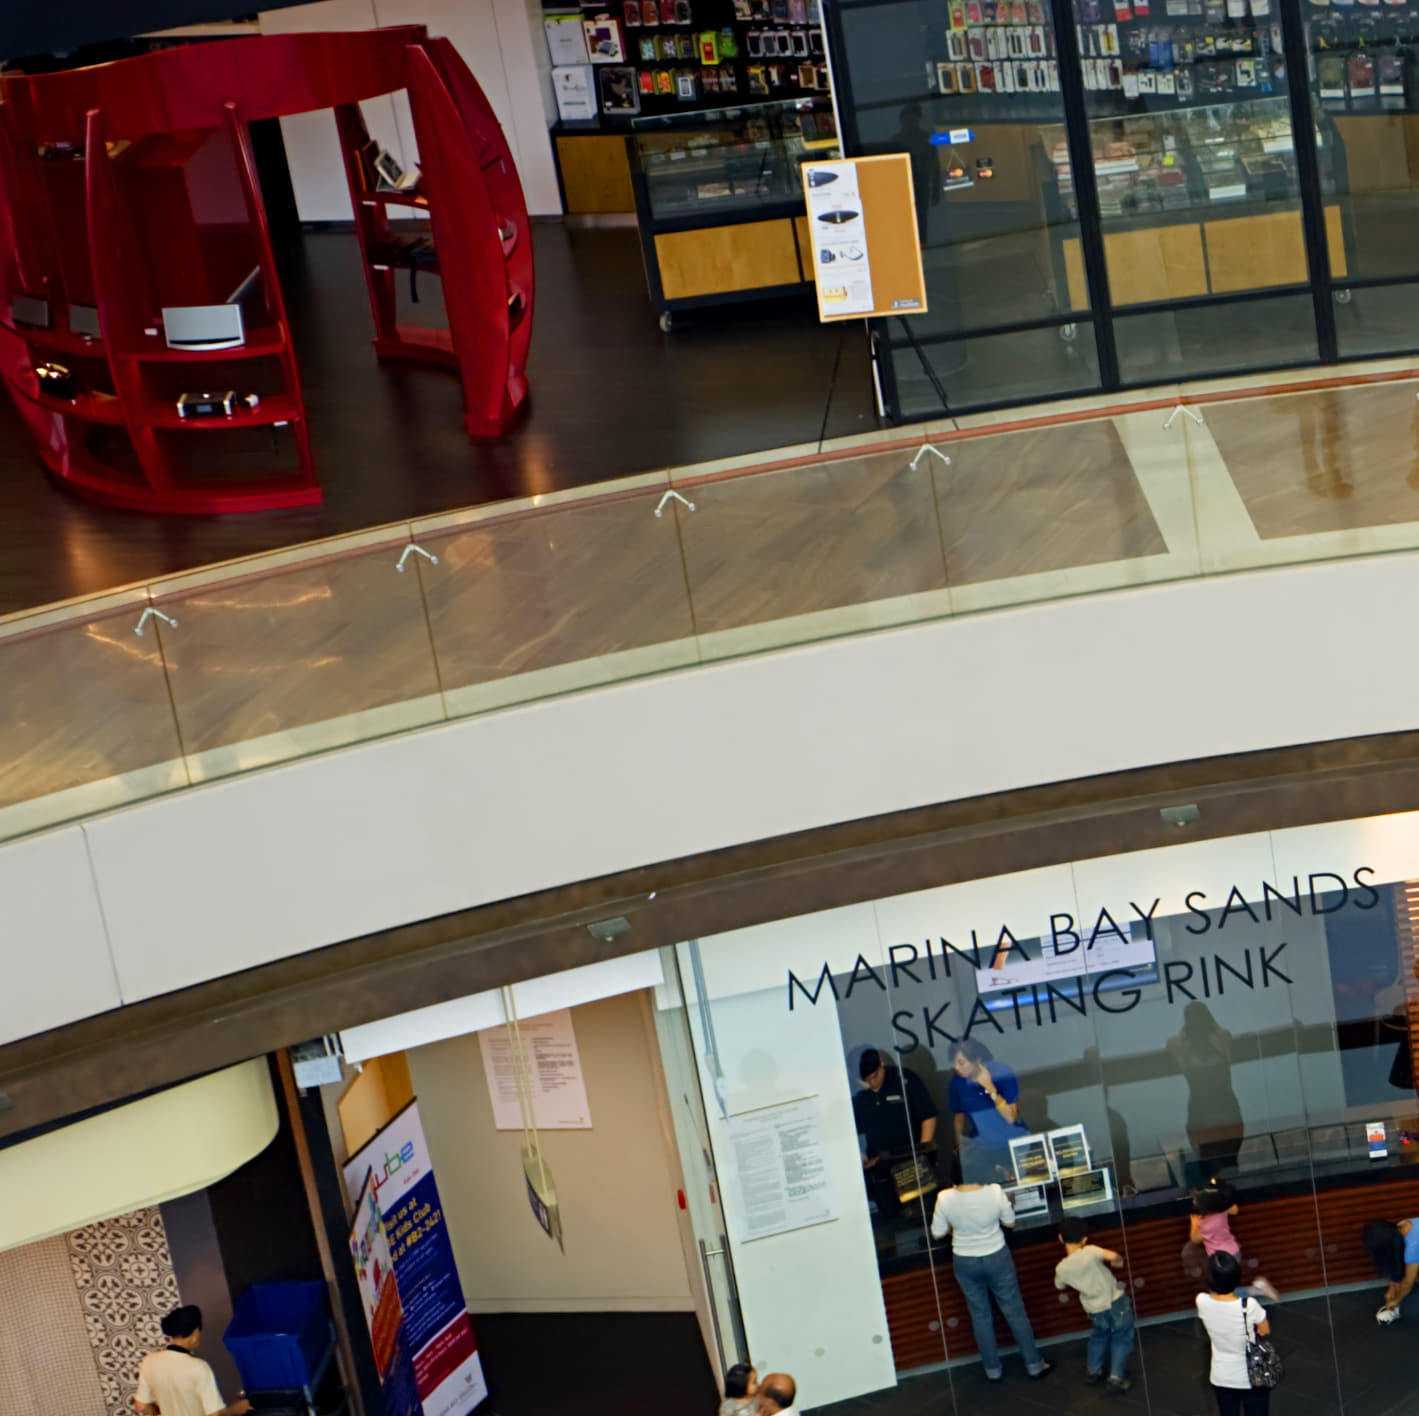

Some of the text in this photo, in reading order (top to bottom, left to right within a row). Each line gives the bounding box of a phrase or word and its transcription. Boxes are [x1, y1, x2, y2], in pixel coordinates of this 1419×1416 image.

[789, 867, 1381, 1011] MARINA BAY SANDS
[891, 942, 1293, 1055] SKATING RINK
